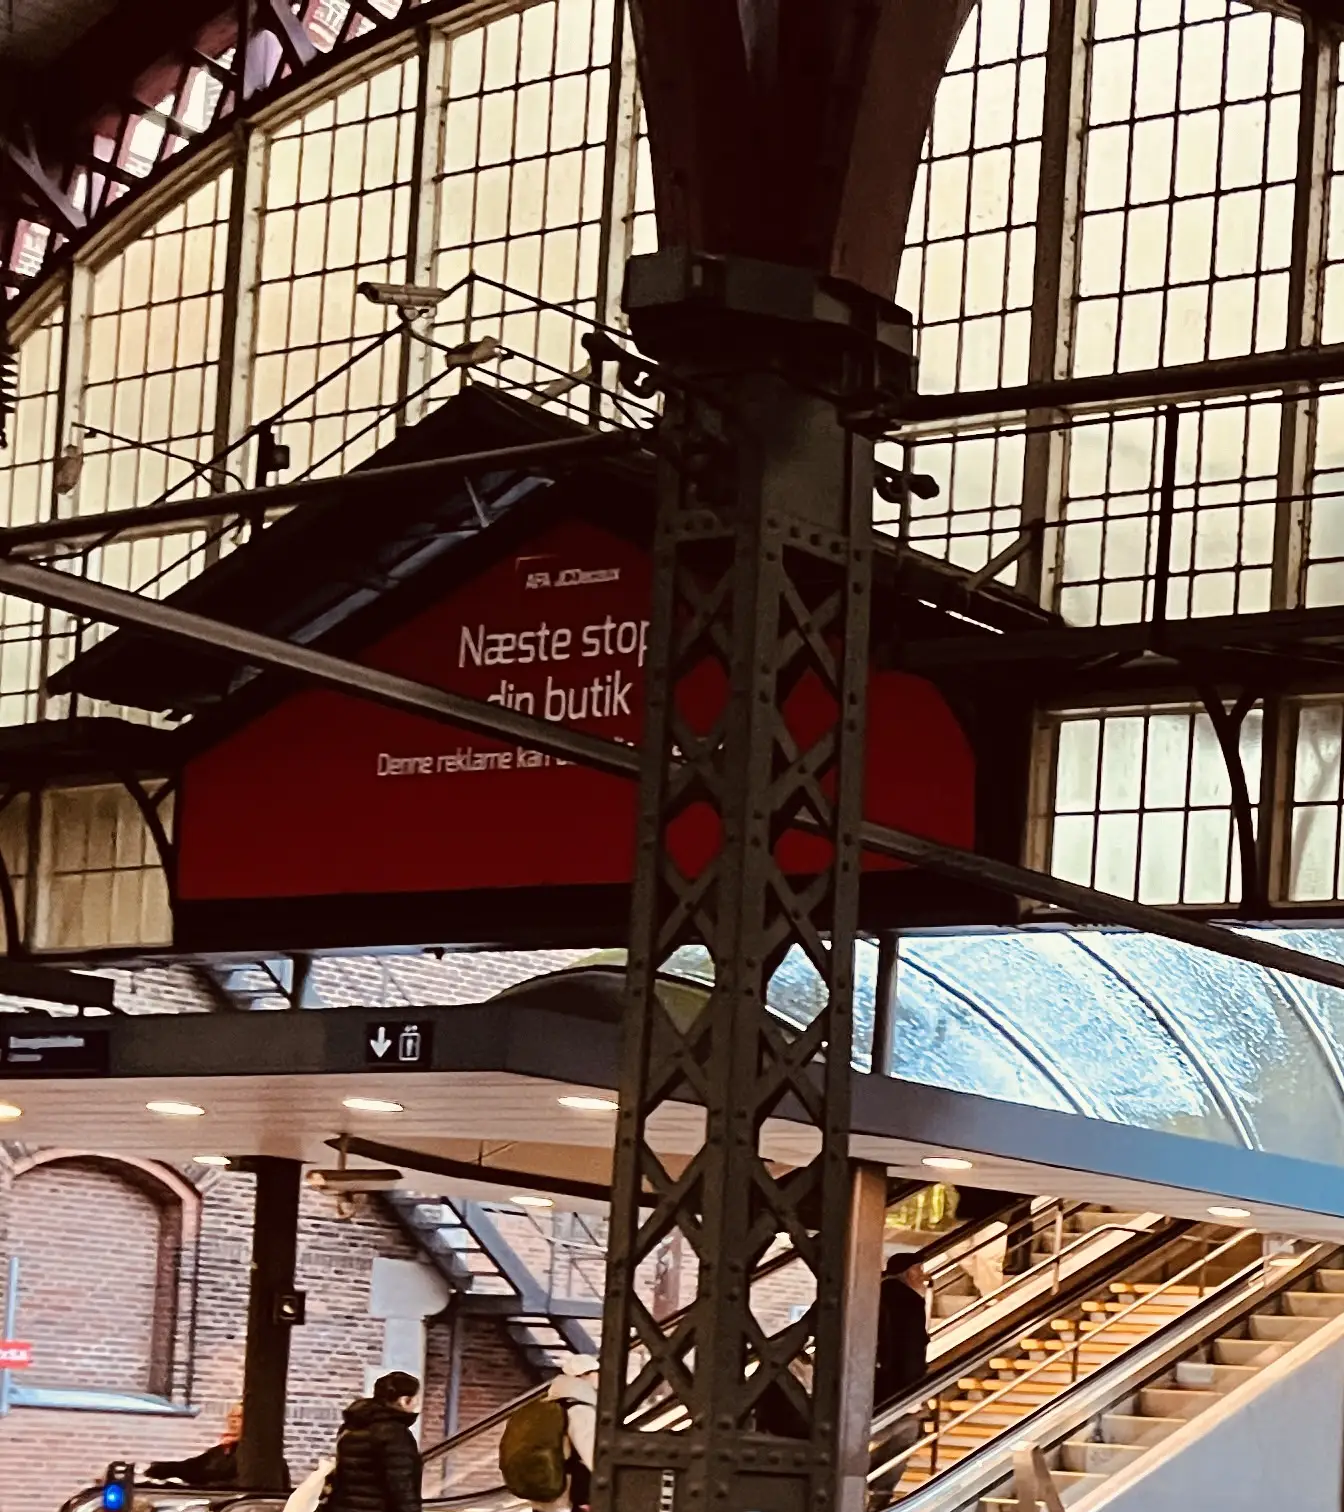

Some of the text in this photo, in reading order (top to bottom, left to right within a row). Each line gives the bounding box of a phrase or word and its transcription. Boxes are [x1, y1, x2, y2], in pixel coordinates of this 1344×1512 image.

[458, 621, 572, 669] Næste
[544, 669, 633, 722] butik
[376, 753, 433, 777] Denne
[436, 747, 512, 774] reklame
